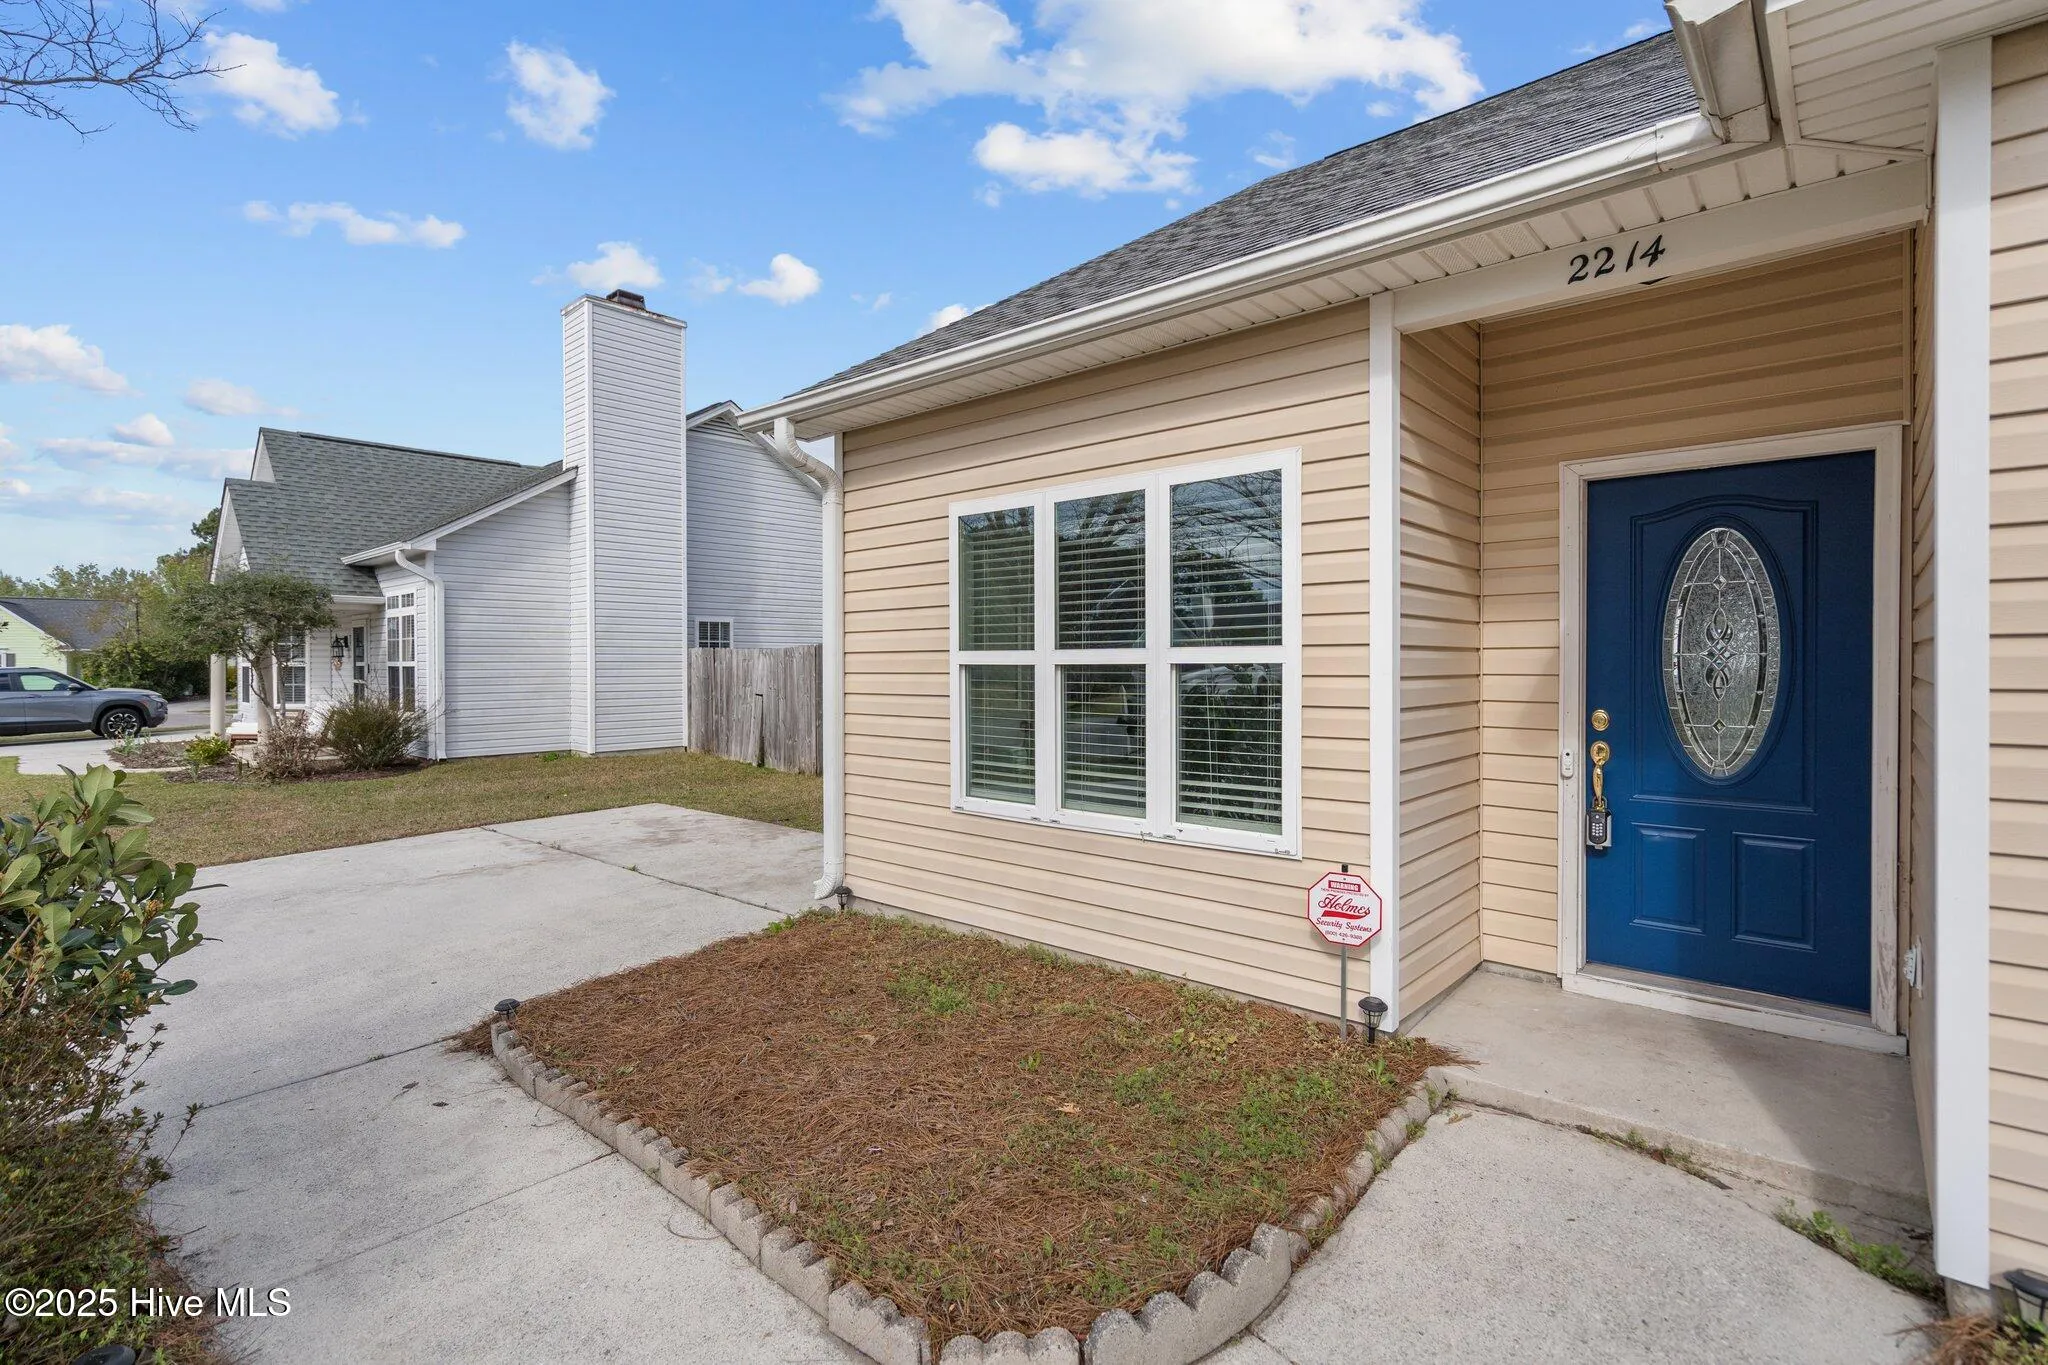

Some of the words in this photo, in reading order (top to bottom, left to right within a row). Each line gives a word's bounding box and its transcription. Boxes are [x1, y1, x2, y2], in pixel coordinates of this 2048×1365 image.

[1567, 234, 1666, 285] 2214
[1330, 881, 1359, 892] WARNING
[1317, 893, 1371, 916] Holmes
[1316, 917, 1343, 930] Security
[1345, 921, 1373, 933] Systems
